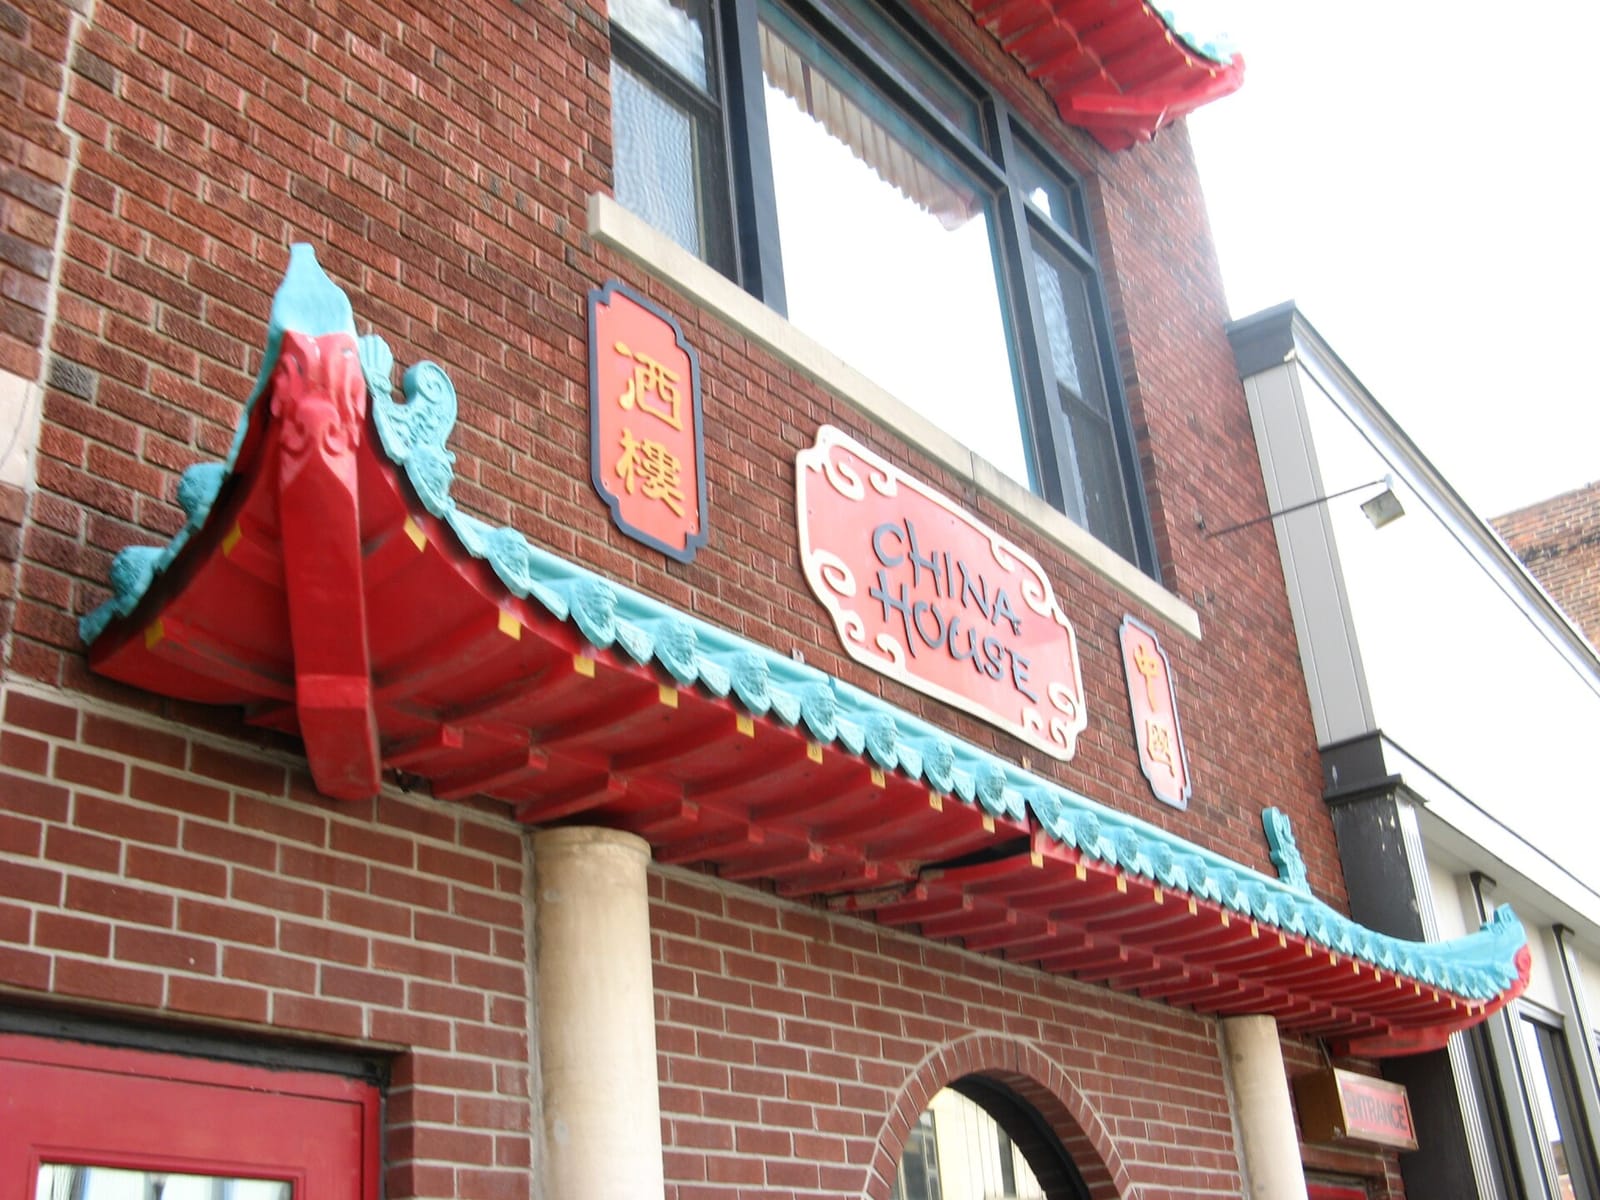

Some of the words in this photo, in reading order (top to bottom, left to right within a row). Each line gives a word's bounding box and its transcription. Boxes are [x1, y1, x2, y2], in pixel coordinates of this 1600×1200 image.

[869, 569, 1039, 703] HOUSE
[872, 517, 1022, 636] CHINA
[1343, 1088, 1409, 1132] ENTRANCE
